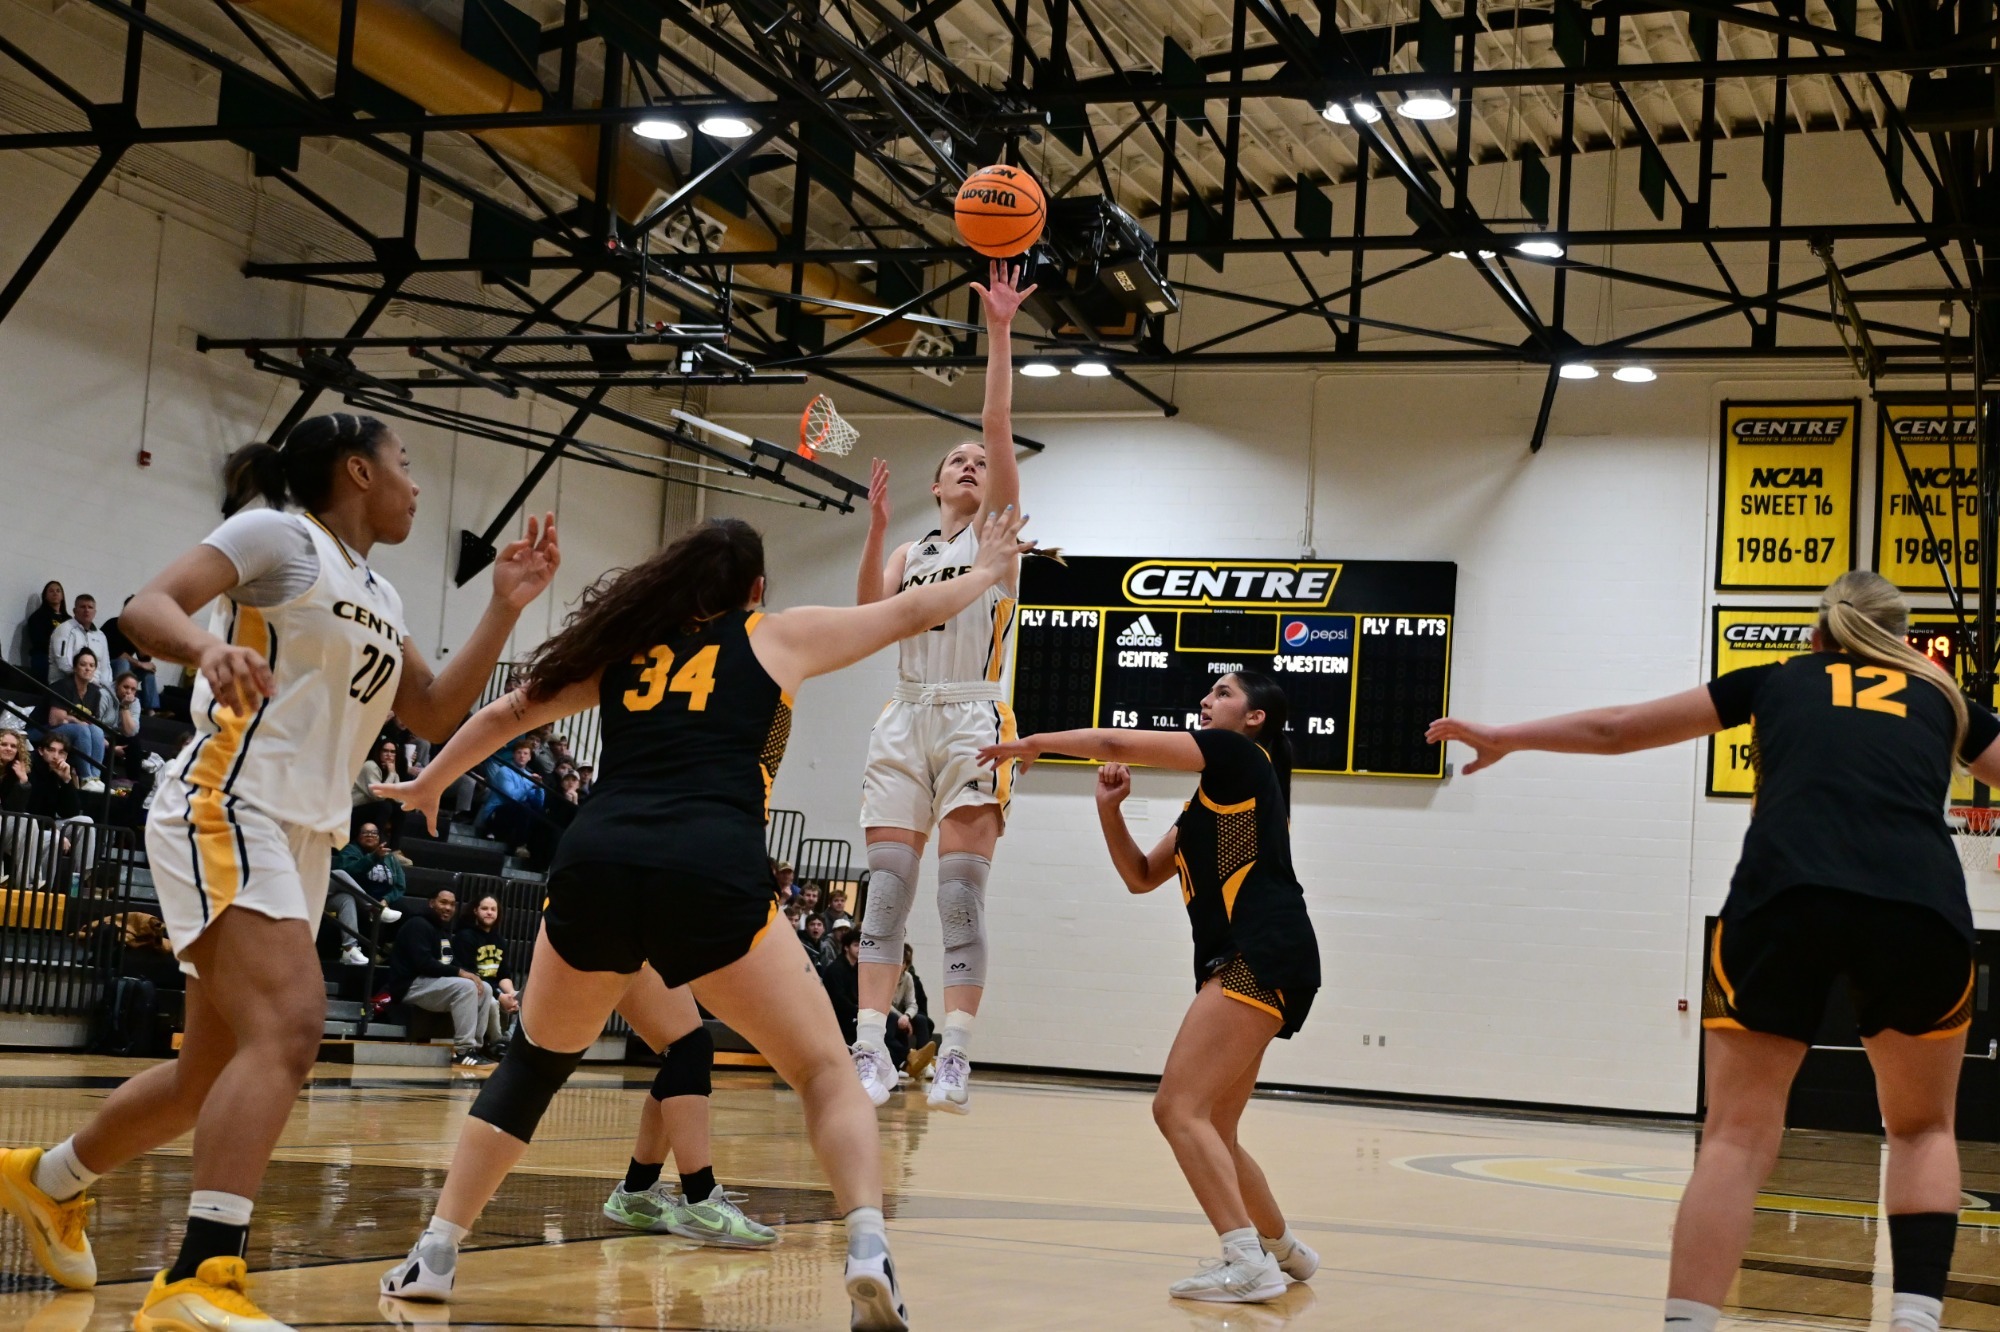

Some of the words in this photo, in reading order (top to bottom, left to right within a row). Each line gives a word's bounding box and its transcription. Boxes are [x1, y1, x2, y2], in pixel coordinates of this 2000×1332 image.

[962, 188, 1017, 209] Wilson
[1735, 420, 1842, 435] CENTRE
[1893, 420, 1977, 435] CENTR
[1750, 467, 1823, 489] NCAA
[1741, 494, 1808, 516] SWEET
[1814, 494, 1833, 516] 16
[1889, 494, 1947, 516] FINAL
[1956, 494, 1978, 516] FO
[1737, 537, 1835, 563] 1986-87
[1130, 569, 1329, 599] CENTRE
[1021, 609, 1046, 627] PLY
[1051, 610, 1069, 627] FL
[1071, 611, 1098, 628] PTS
[1362, 617, 1390, 635] PLY
[1395, 618, 1414, 636] FL
[1417, 619, 1446, 637] PTS
[1116, 632, 1163, 647] adidas
[1310, 629, 1348, 642] pepsi
[1726, 626, 1815, 641] CENTR
[1732, 641, 1763, 649] MEN'S
[1118, 650, 1169, 669] CENTRE
[1207, 662, 1244, 675] PERIOD
[1273, 654, 1349, 674] S'WESTERN
[349, 644, 396, 705] 20
[622, 644, 721, 712] 34
[1825, 662, 1907, 719] 12
[1112, 710, 1138, 728] FLS
[1152, 715, 1179, 728] T.O.L.
[1186, 713, 1201, 730] PL
[1308, 717, 1335, 735] FLS
